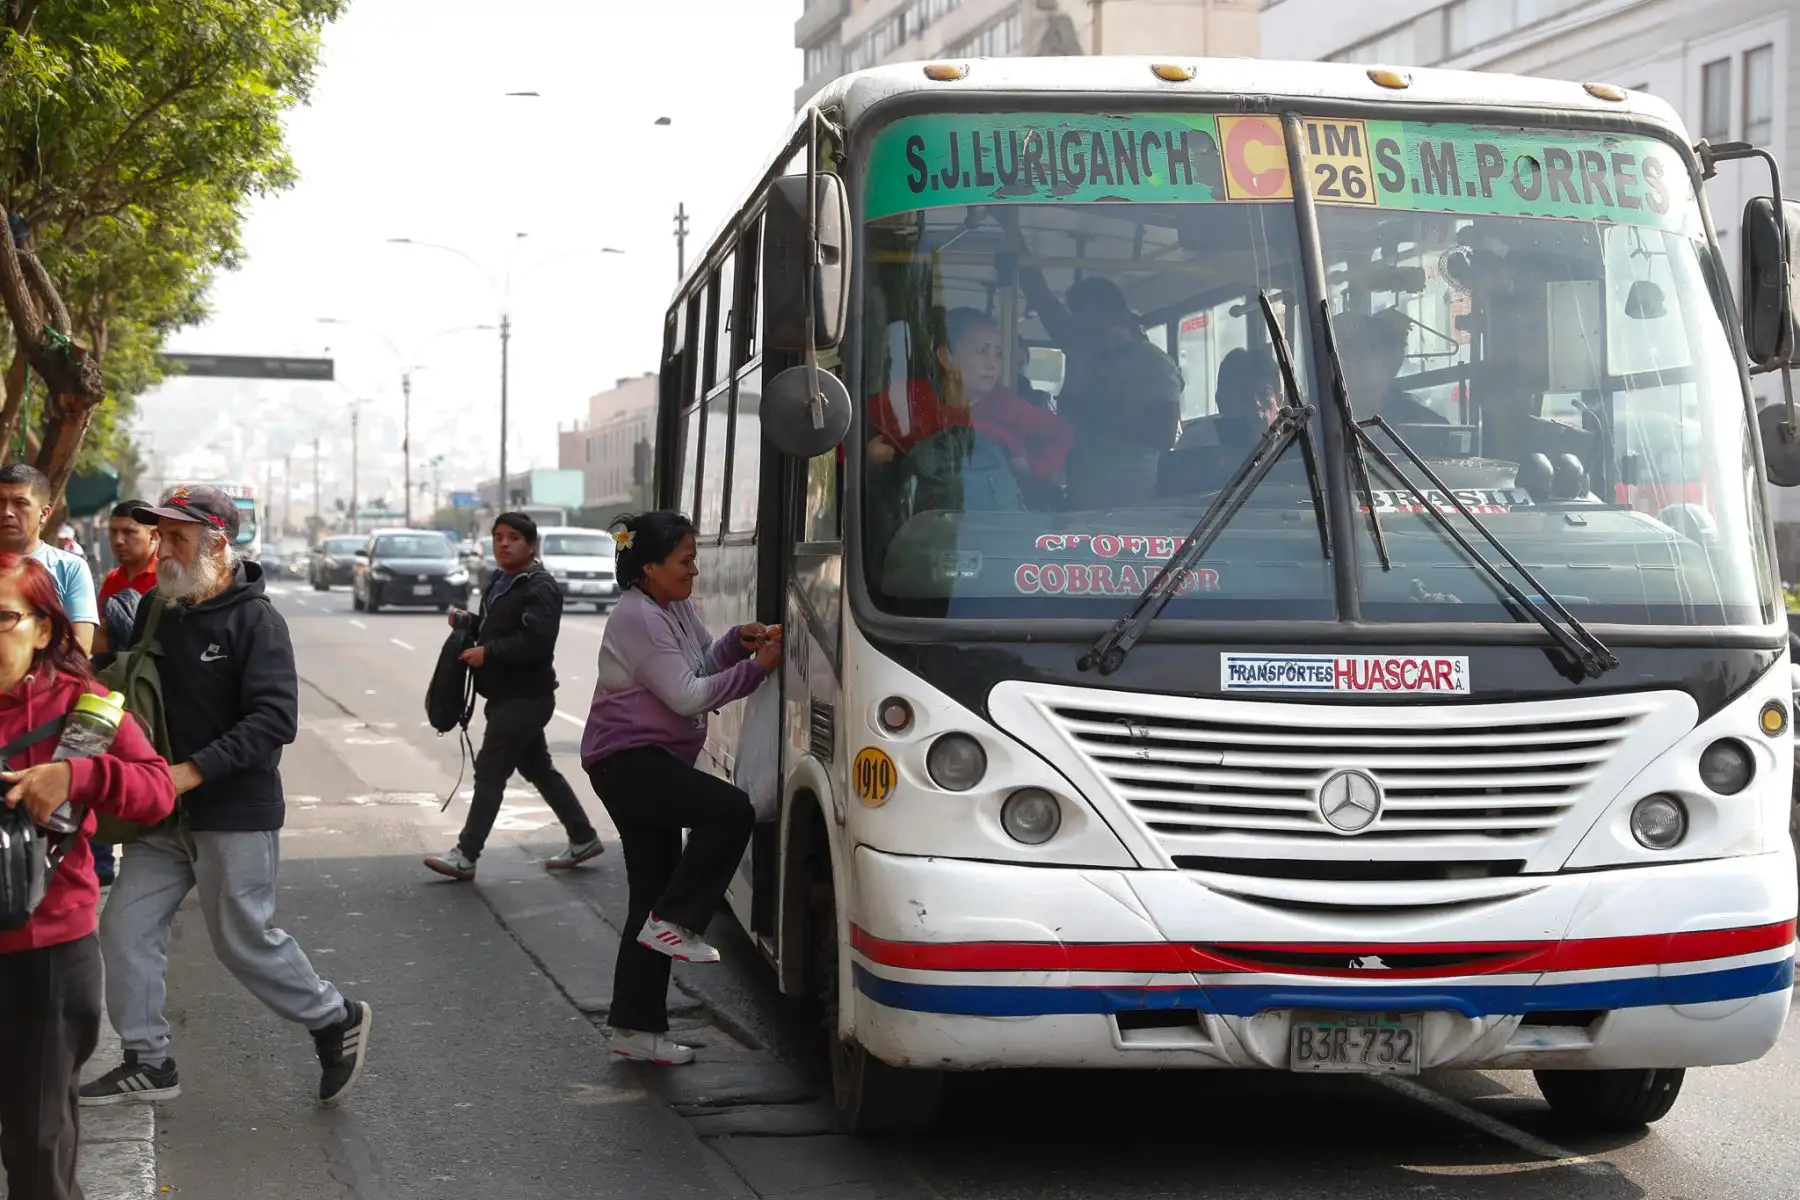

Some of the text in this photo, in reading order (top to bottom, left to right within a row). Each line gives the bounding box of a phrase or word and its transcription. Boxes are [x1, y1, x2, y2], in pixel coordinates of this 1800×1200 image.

[1226, 118, 1287, 197] C
[1306, 123, 1362, 158] IM
[1314, 163, 1367, 199] 26
[1375, 137, 1669, 215] S.M.PORRES
[1228, 658, 1454, 690] TRANSPORTES HUASCAR
[856, 757, 890, 800] 1919
[1297, 1027, 1413, 1065] B3R-732
